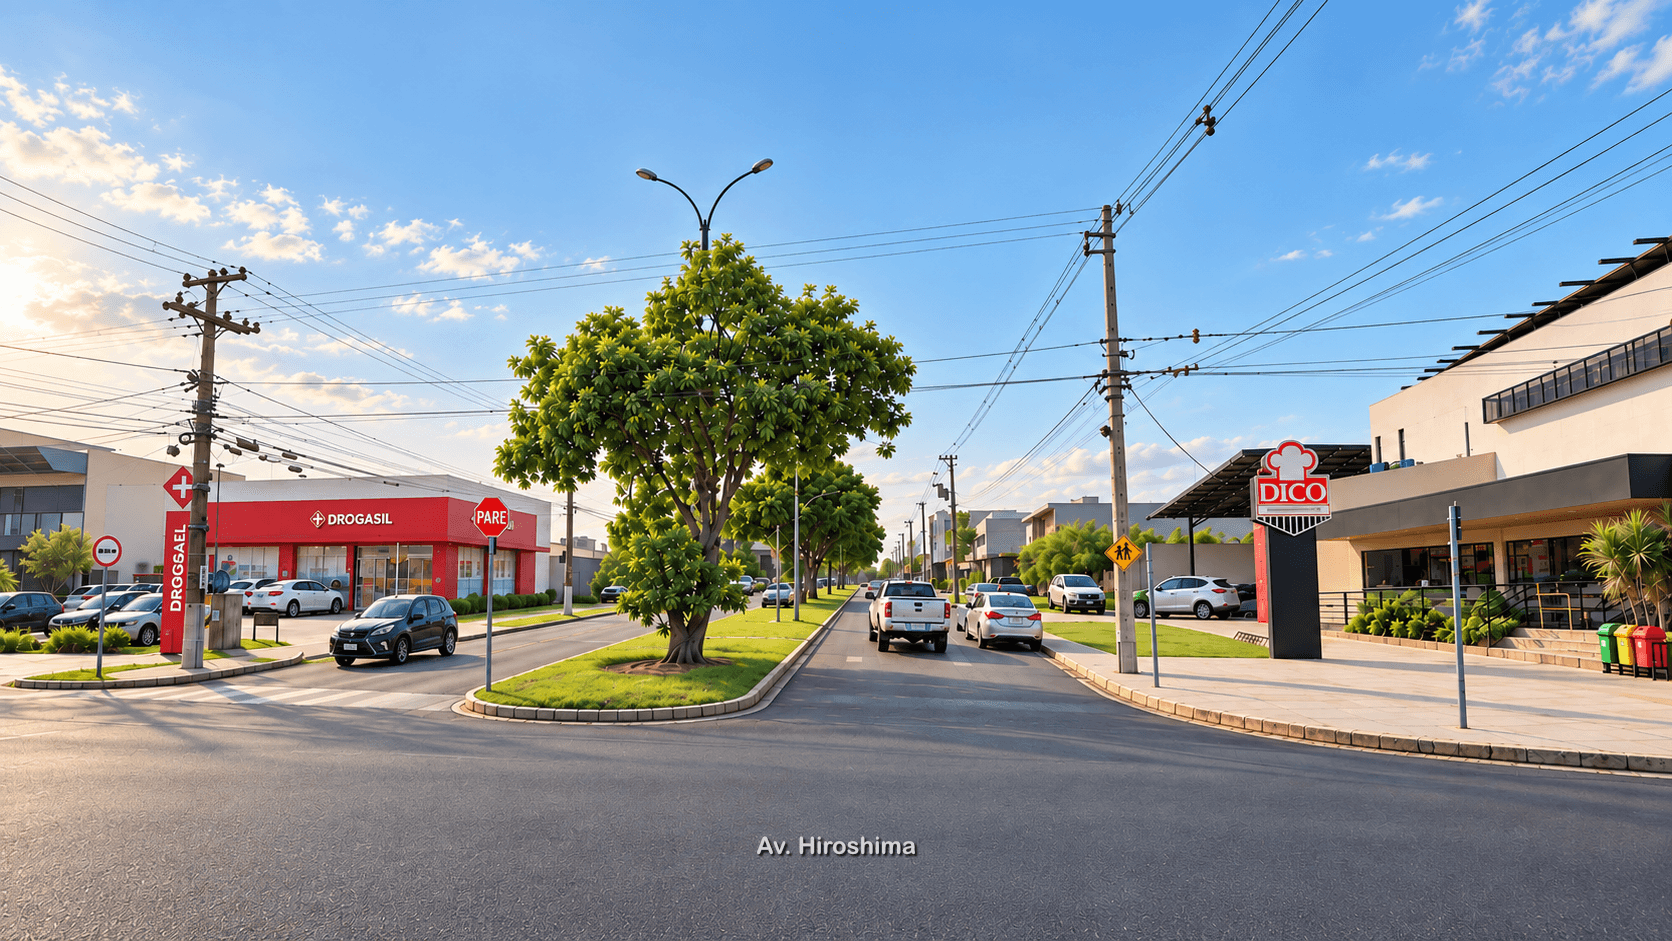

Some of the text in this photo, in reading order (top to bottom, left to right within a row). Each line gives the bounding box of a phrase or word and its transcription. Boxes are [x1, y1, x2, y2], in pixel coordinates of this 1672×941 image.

[1260, 483, 1327, 502] DICO
[328, 513, 393, 525] DROGASIL
[477, 510, 507, 525] PARE
